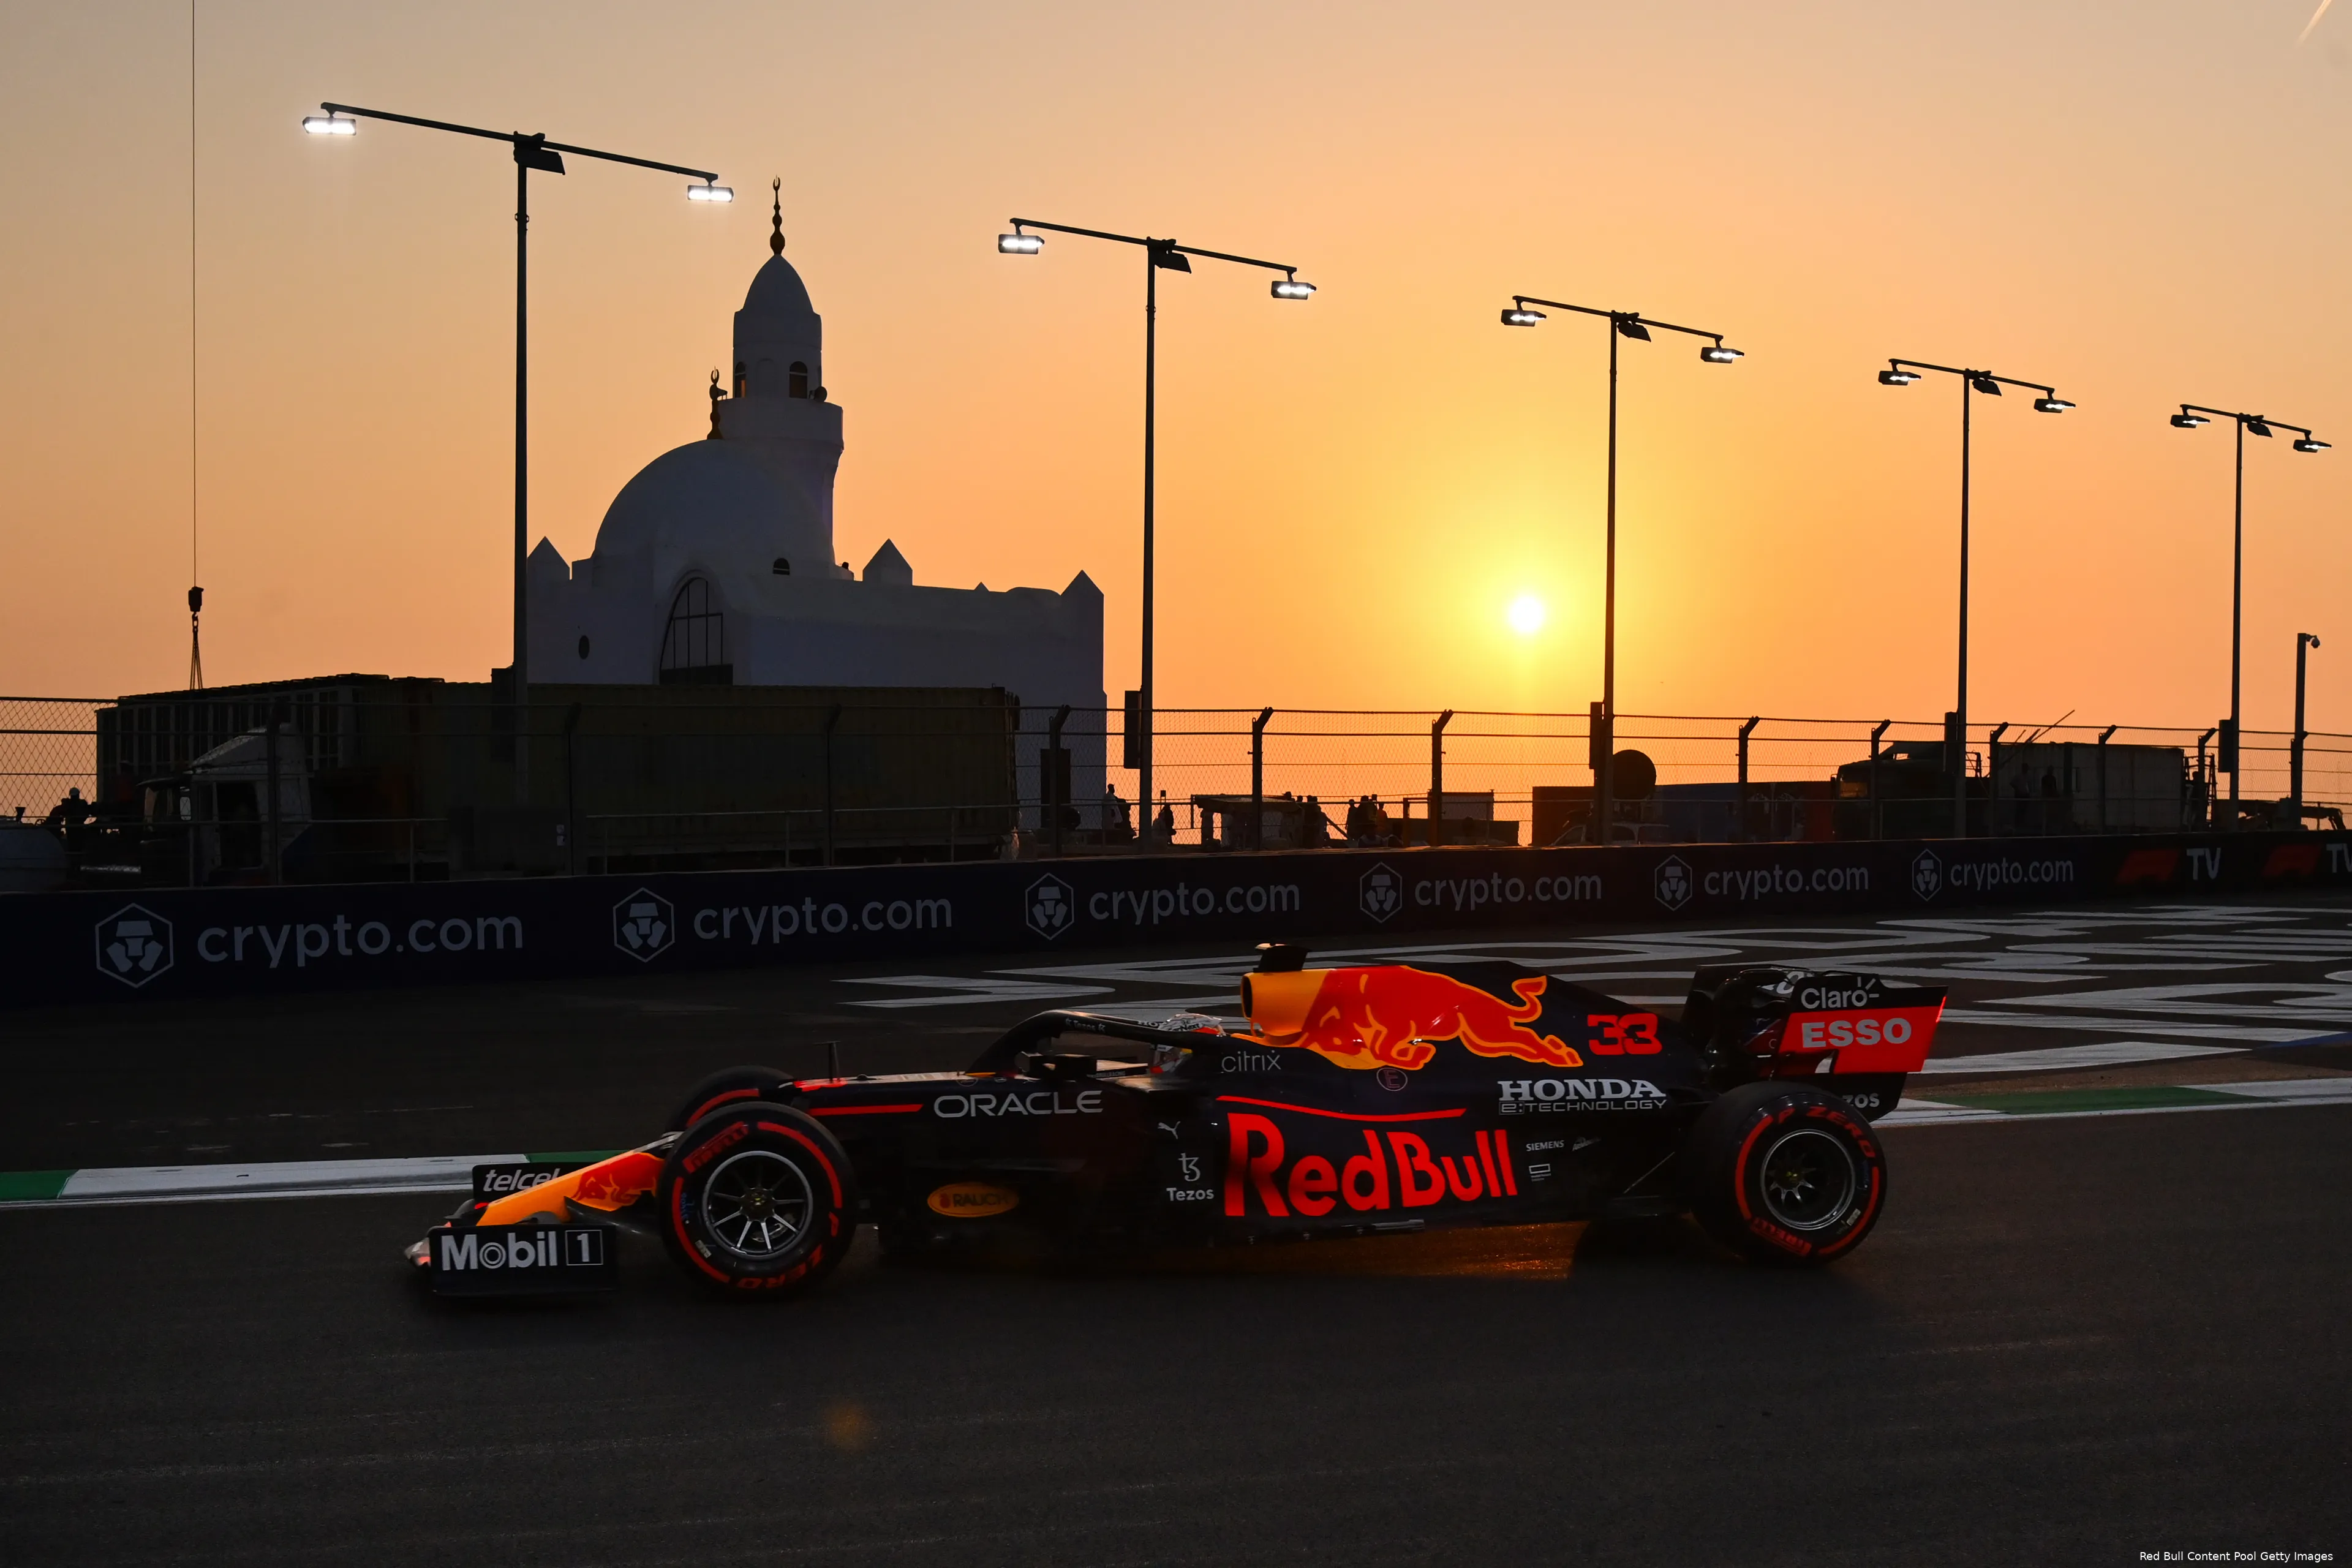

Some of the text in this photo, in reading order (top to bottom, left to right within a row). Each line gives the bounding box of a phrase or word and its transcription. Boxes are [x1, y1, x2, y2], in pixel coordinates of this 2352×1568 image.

[1950, 858, 2074, 891] crypto.com
[2186, 847, 2222, 881] TV
[1414, 872, 1602, 911] crypto.com
[1703, 864, 1869, 900] crypto.com
[1089, 882, 1300, 925] crypto.com
[693, 897, 952, 945] crypto.com
[197, 914, 524, 969] crypto.com
[1801, 987, 1868, 1009] Claro
[1586, 1012, 1663, 1055] 33
[1801, 1017, 1912, 1049] ESSO
[1221, 1050, 1281, 1072] citrix
[933, 1090, 1103, 1118] ORACLE
[1497, 1079, 1667, 1101] HONDA
[1526, 1140, 1565, 1152] SIEMENS
[1166, 1187, 1215, 1202] Tezos
[440, 1231, 559, 1272] Mobil
